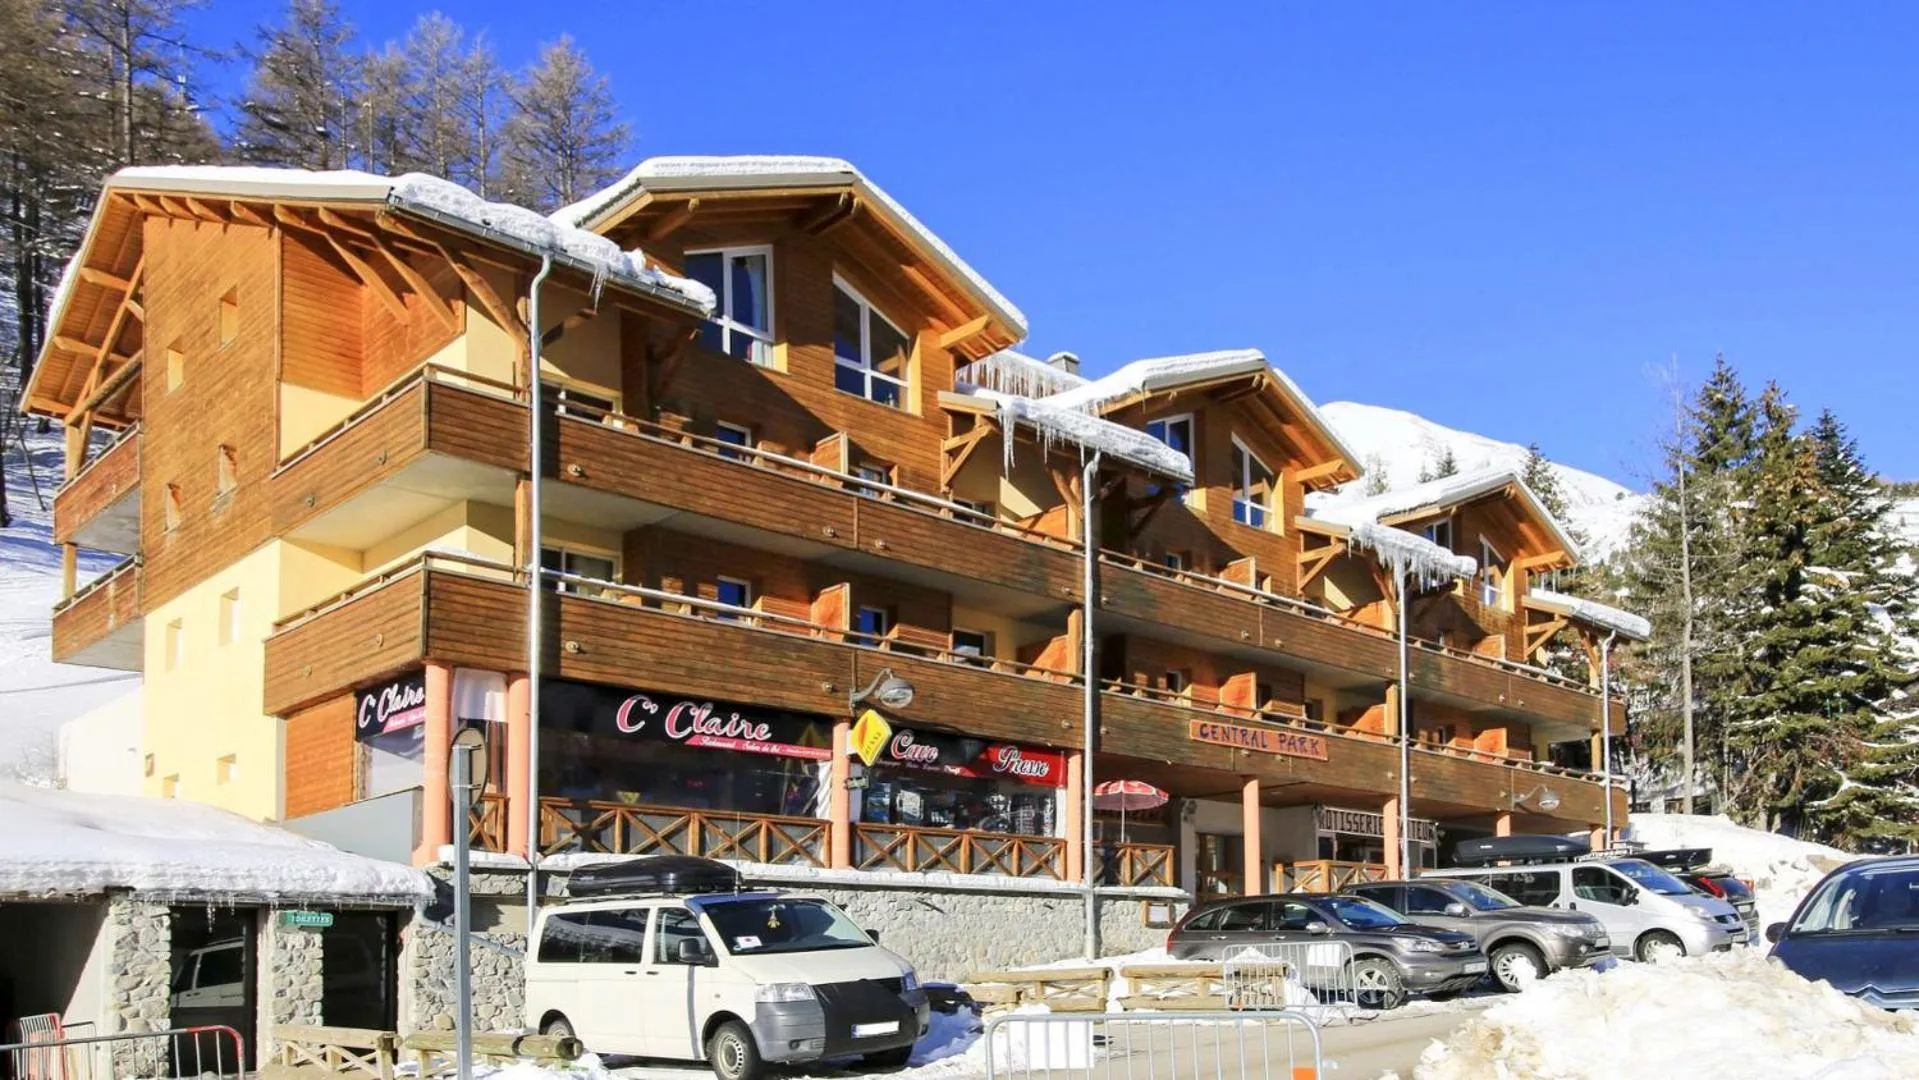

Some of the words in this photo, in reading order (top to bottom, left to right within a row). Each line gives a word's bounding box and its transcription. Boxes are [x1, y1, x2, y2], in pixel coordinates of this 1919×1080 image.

[377, 683, 425, 723] Claire
[665, 701, 772, 741] Claire
[1199, 723, 1268, 748] CENTRAL
[1277, 733, 1320, 755] PARK
